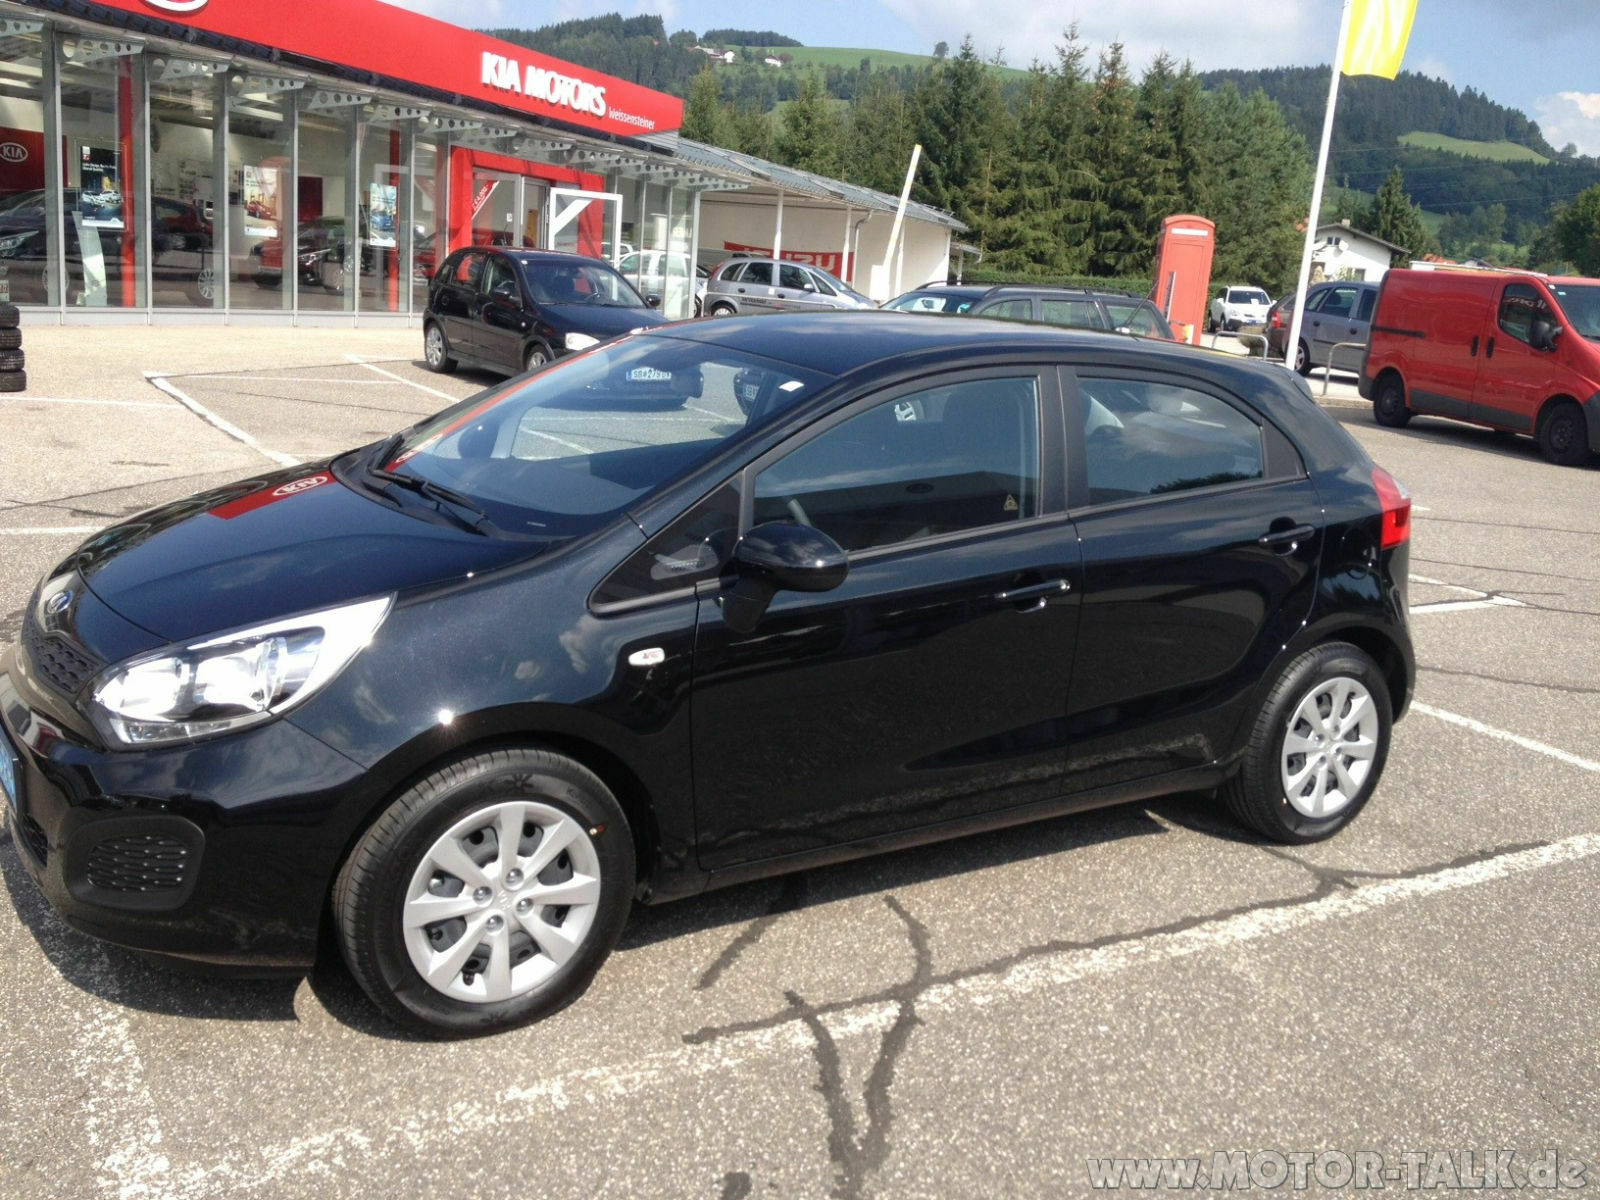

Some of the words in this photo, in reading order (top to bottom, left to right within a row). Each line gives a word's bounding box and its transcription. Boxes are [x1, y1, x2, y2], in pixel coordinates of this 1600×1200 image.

[482, 51, 521, 93] KIA
[525, 65, 607, 117] MOTORS
[2, 145, 24, 159] KIA
